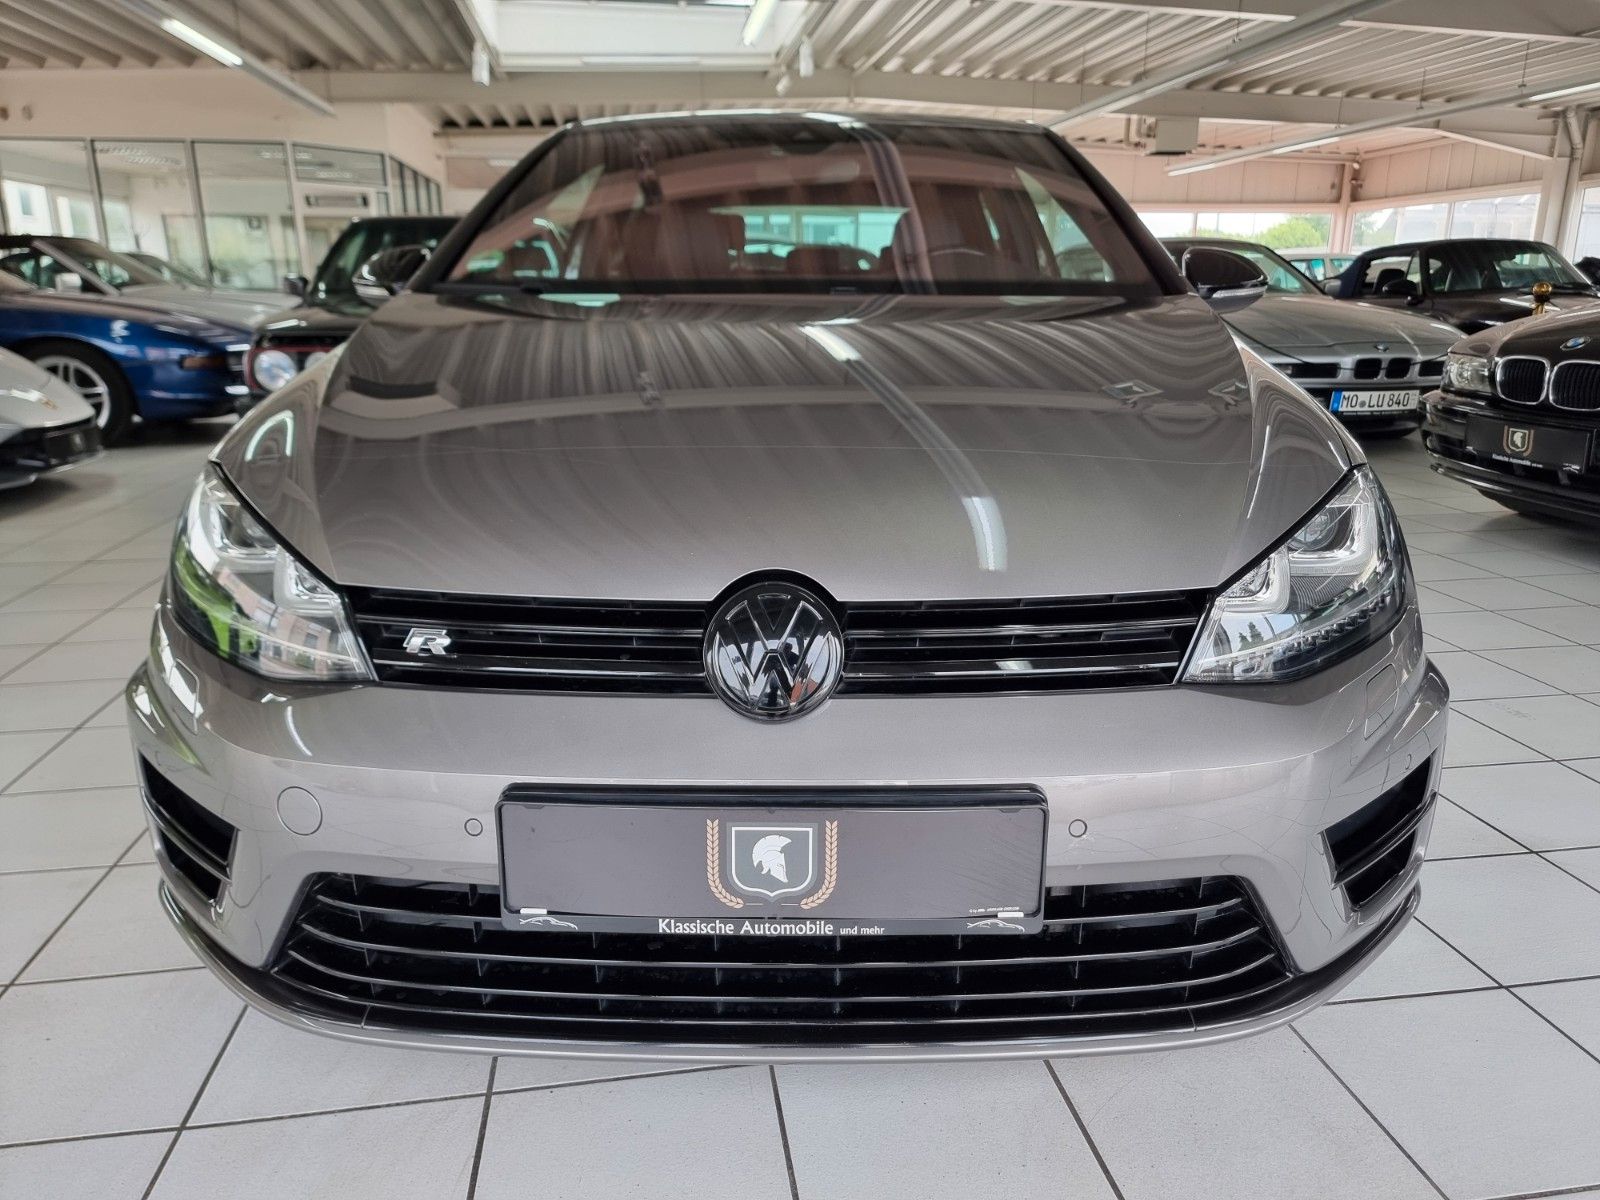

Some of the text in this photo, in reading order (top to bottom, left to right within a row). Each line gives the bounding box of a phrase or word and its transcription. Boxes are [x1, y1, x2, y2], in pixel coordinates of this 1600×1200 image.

[1341, 392, 1410, 408] MO LU 840
[403, 627, 452, 655] R
[658, 918, 885, 935] Klassische Automobile und mehr
